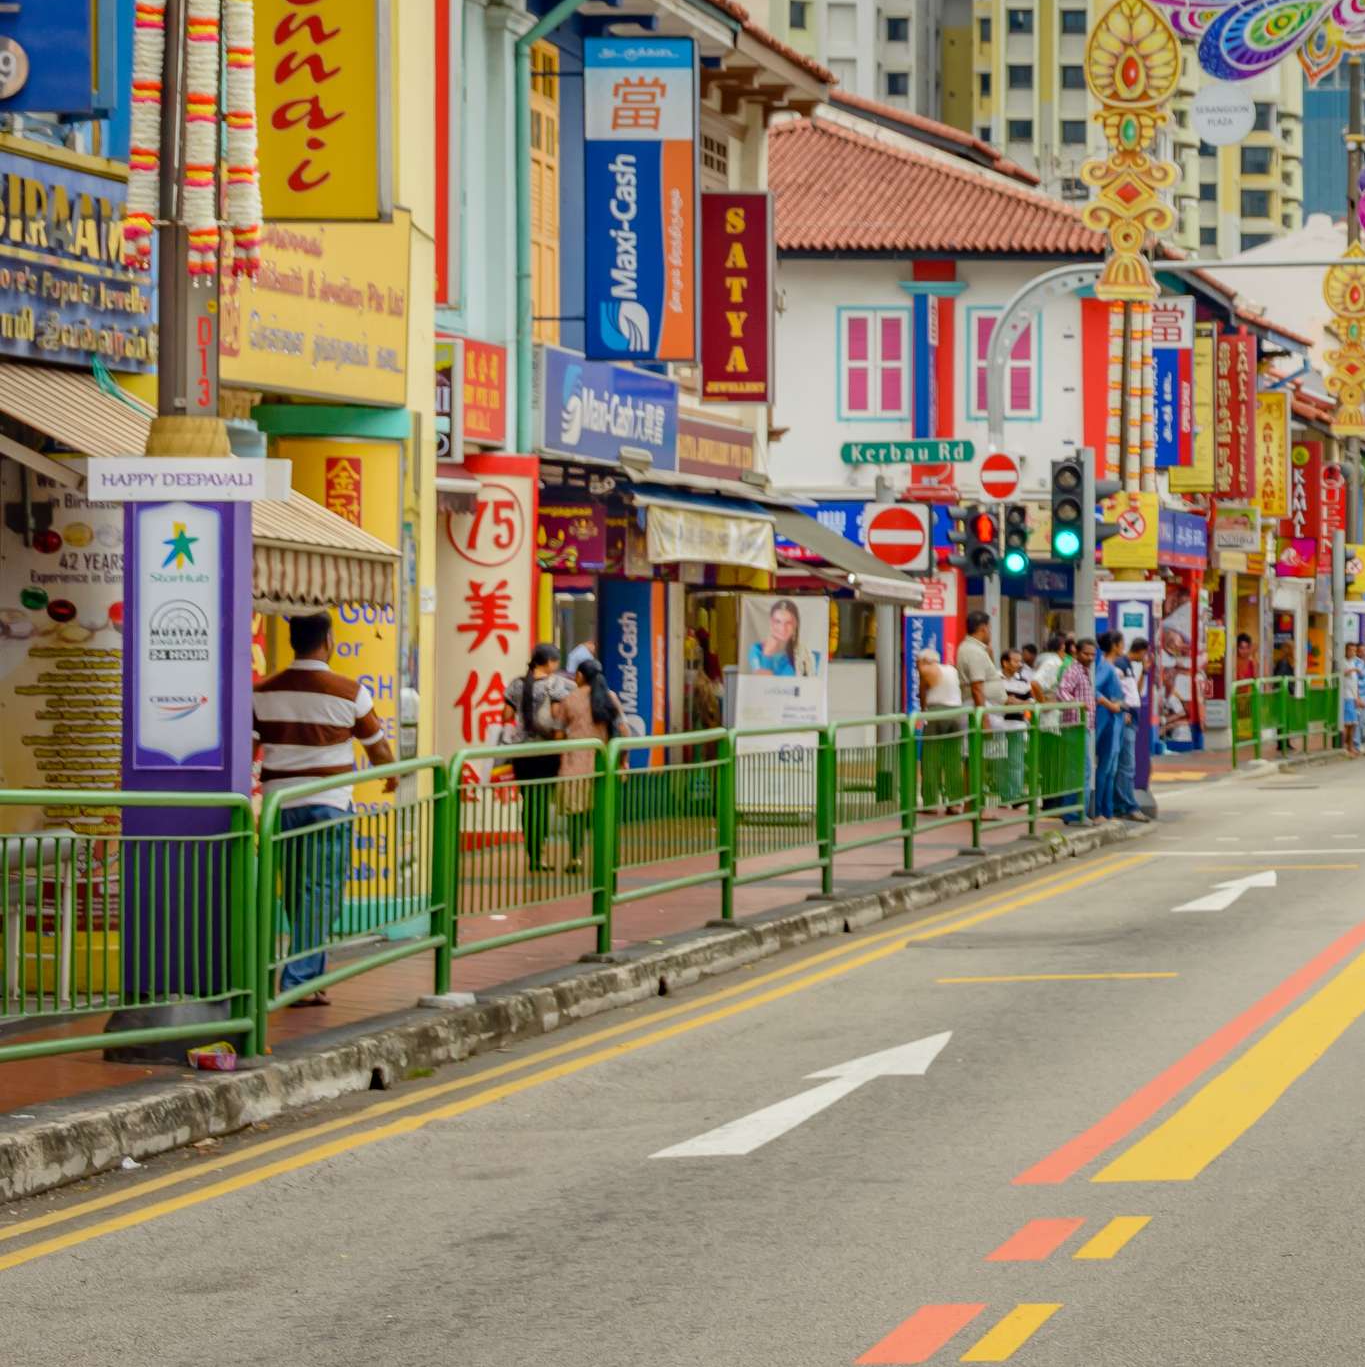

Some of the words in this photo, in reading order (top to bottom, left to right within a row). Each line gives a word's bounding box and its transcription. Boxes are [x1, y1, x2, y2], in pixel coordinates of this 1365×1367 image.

[608, 153, 638, 300] Maxi-Cash
[724, 207, 749, 373] SATYA
[851, 443, 929, 463] Kerbau
[938, 441, 964, 462] Rd
[101, 473, 158, 487] HAPPY
[161, 473, 254, 487] DEEPAVALI
[1292, 468, 1307, 538] KAMAL
[467, 500, 516, 550] 75
[59, 553, 78, 570] 42
[30, 570, 88, 584] Experience
[150, 629, 208, 637] MUSTAFA
[337, 641, 362, 657] or
[618, 611, 638, 714] Maxi-Cash
